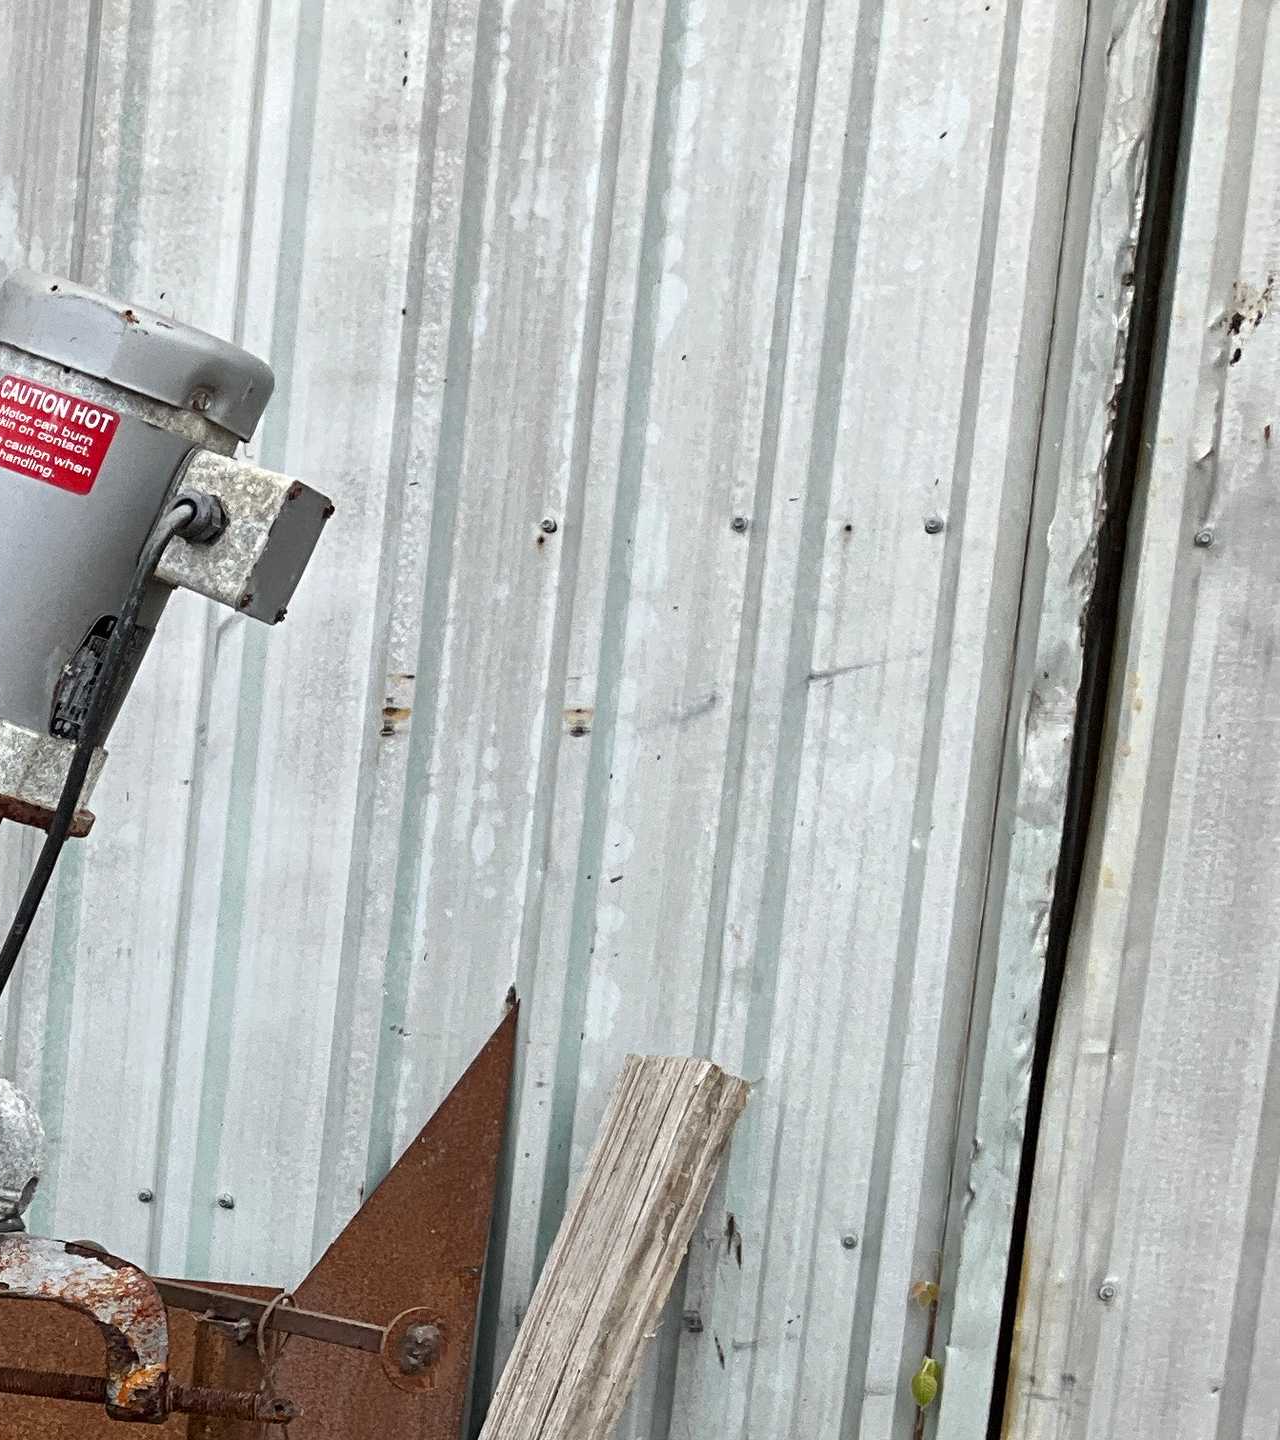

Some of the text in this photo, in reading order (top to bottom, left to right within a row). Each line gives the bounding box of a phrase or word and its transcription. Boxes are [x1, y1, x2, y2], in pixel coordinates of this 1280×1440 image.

[0, 379, 114, 433] CAUTION HOT
[0, 404, 94, 446] Motor can burn
[4, 438, 51, 462] caution
[54, 454, 93, 477] when
[18, 425, 34, 437] on
[37, 431, 90, 457] contact.
